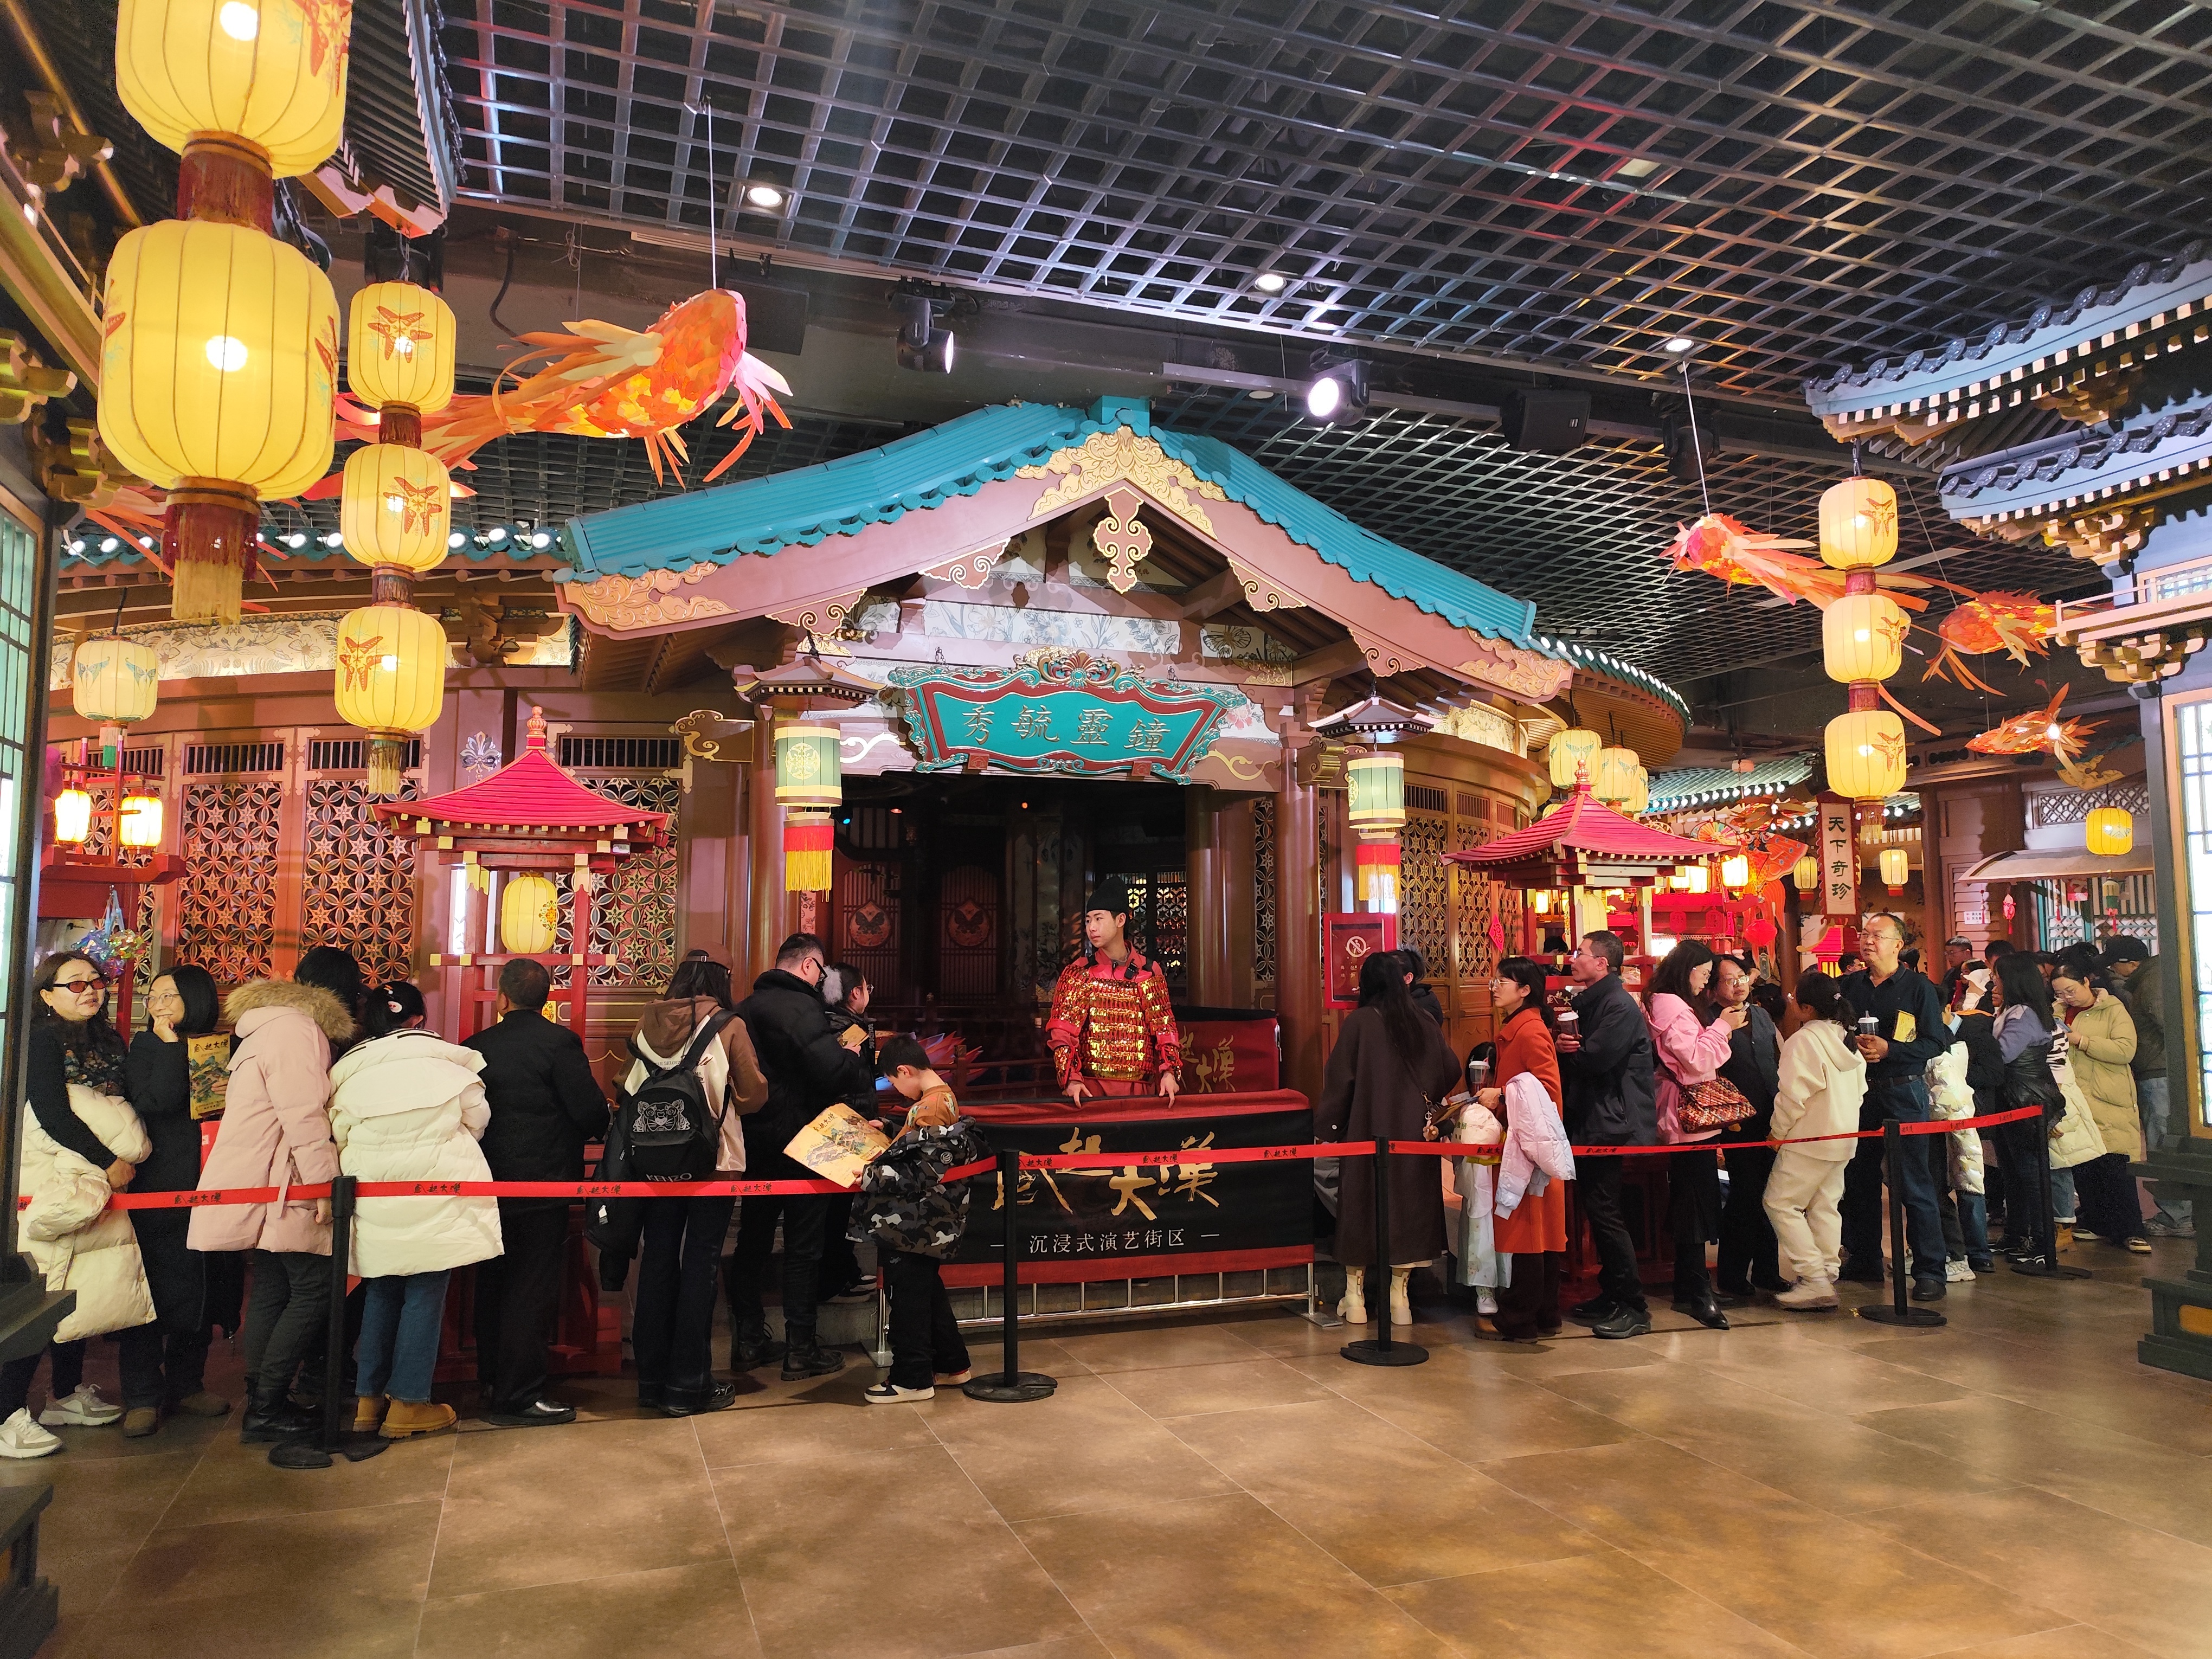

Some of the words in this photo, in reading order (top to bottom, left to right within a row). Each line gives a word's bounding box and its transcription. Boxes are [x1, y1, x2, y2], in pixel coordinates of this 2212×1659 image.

[1828, 816, 1852, 900] 天下奇珍
[646, 1172, 692, 1182] KENZO
[1029, 1227, 1185, 1254] 沉浸式演艺街区
